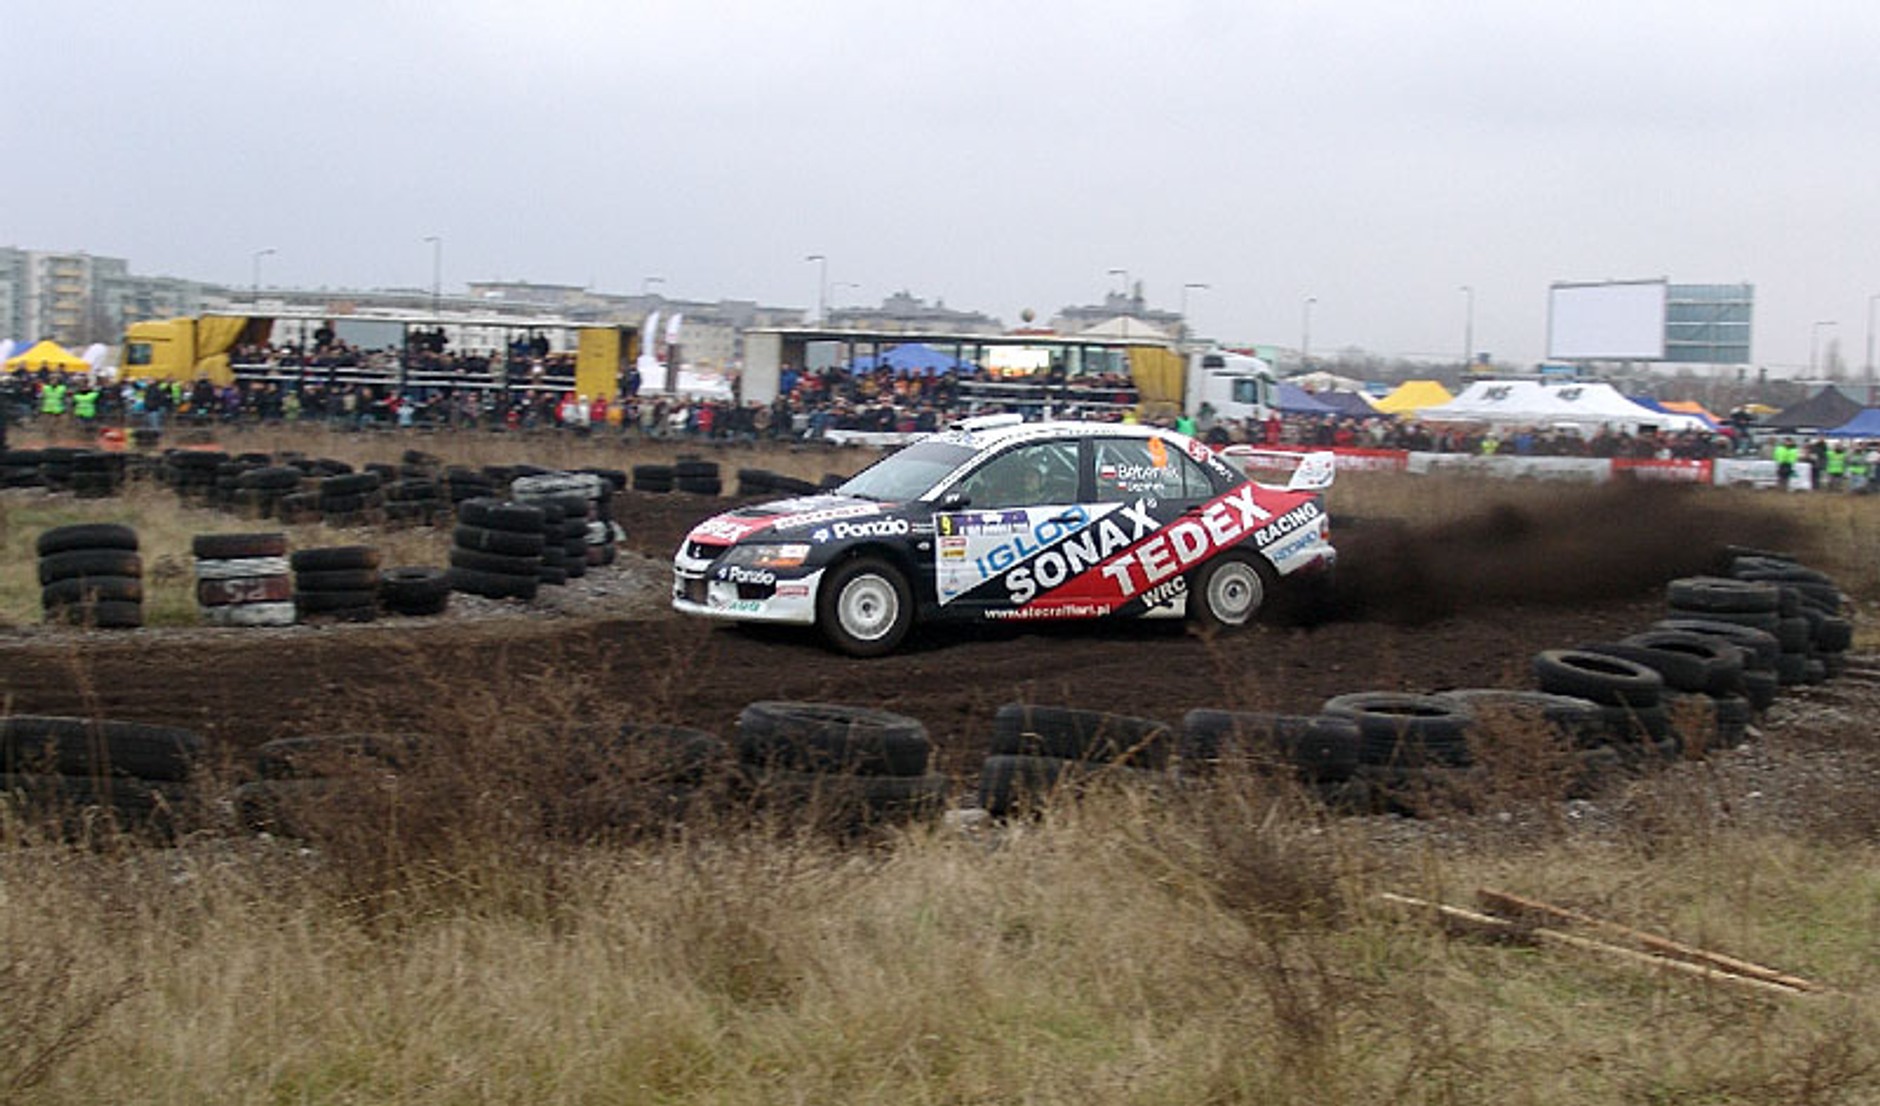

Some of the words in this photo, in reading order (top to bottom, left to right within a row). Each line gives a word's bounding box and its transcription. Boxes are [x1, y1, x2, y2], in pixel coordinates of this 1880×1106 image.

[1147, 436, 1168, 468] 9
[832, 516, 909, 538] Ponzio
[942, 515, 952, 536] 9
[1254, 502, 1318, 547] RACING
[1005, 498, 1162, 605] SONAX
[1103, 485, 1271, 599] TEDEX
[729, 566, 776, 584] Ponzio
[1141, 575, 1187, 608] WRC
